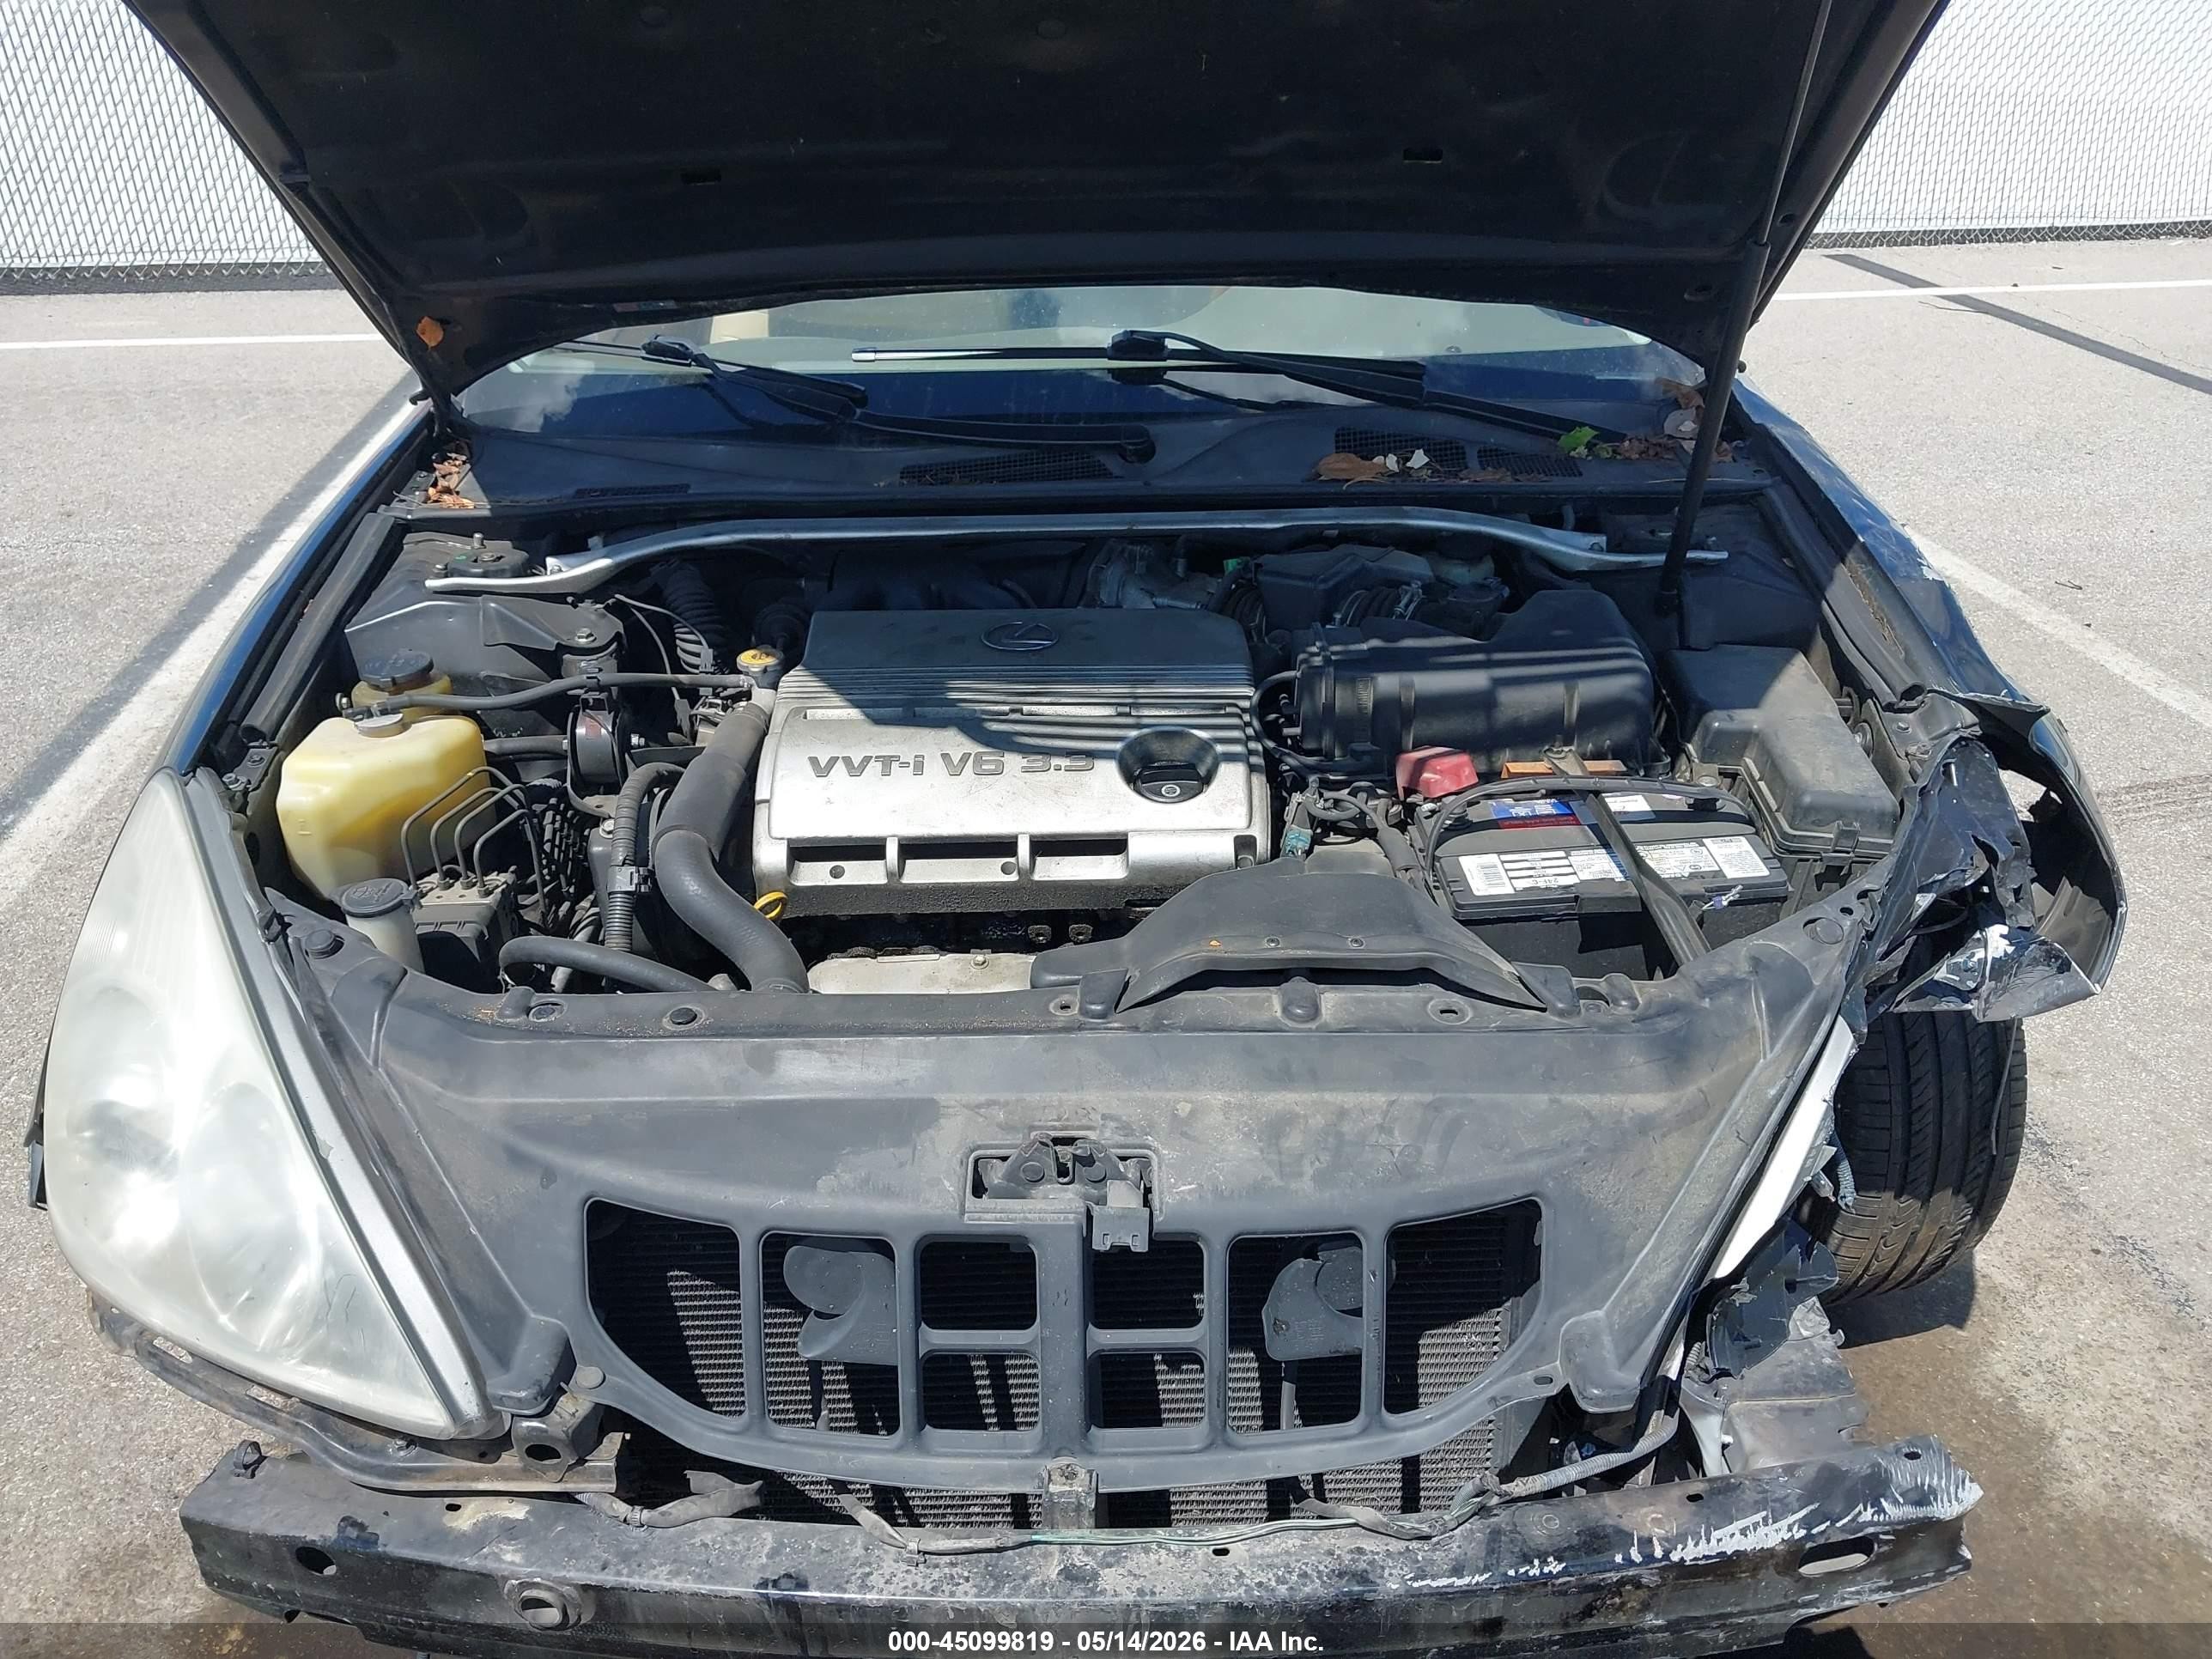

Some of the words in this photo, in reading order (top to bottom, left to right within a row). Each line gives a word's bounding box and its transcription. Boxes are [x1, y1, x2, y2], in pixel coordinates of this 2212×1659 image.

[807, 754, 926, 777] VVT-i
[940, 751, 1005, 776] V6
[1021, 751, 1095, 773] 3.3
